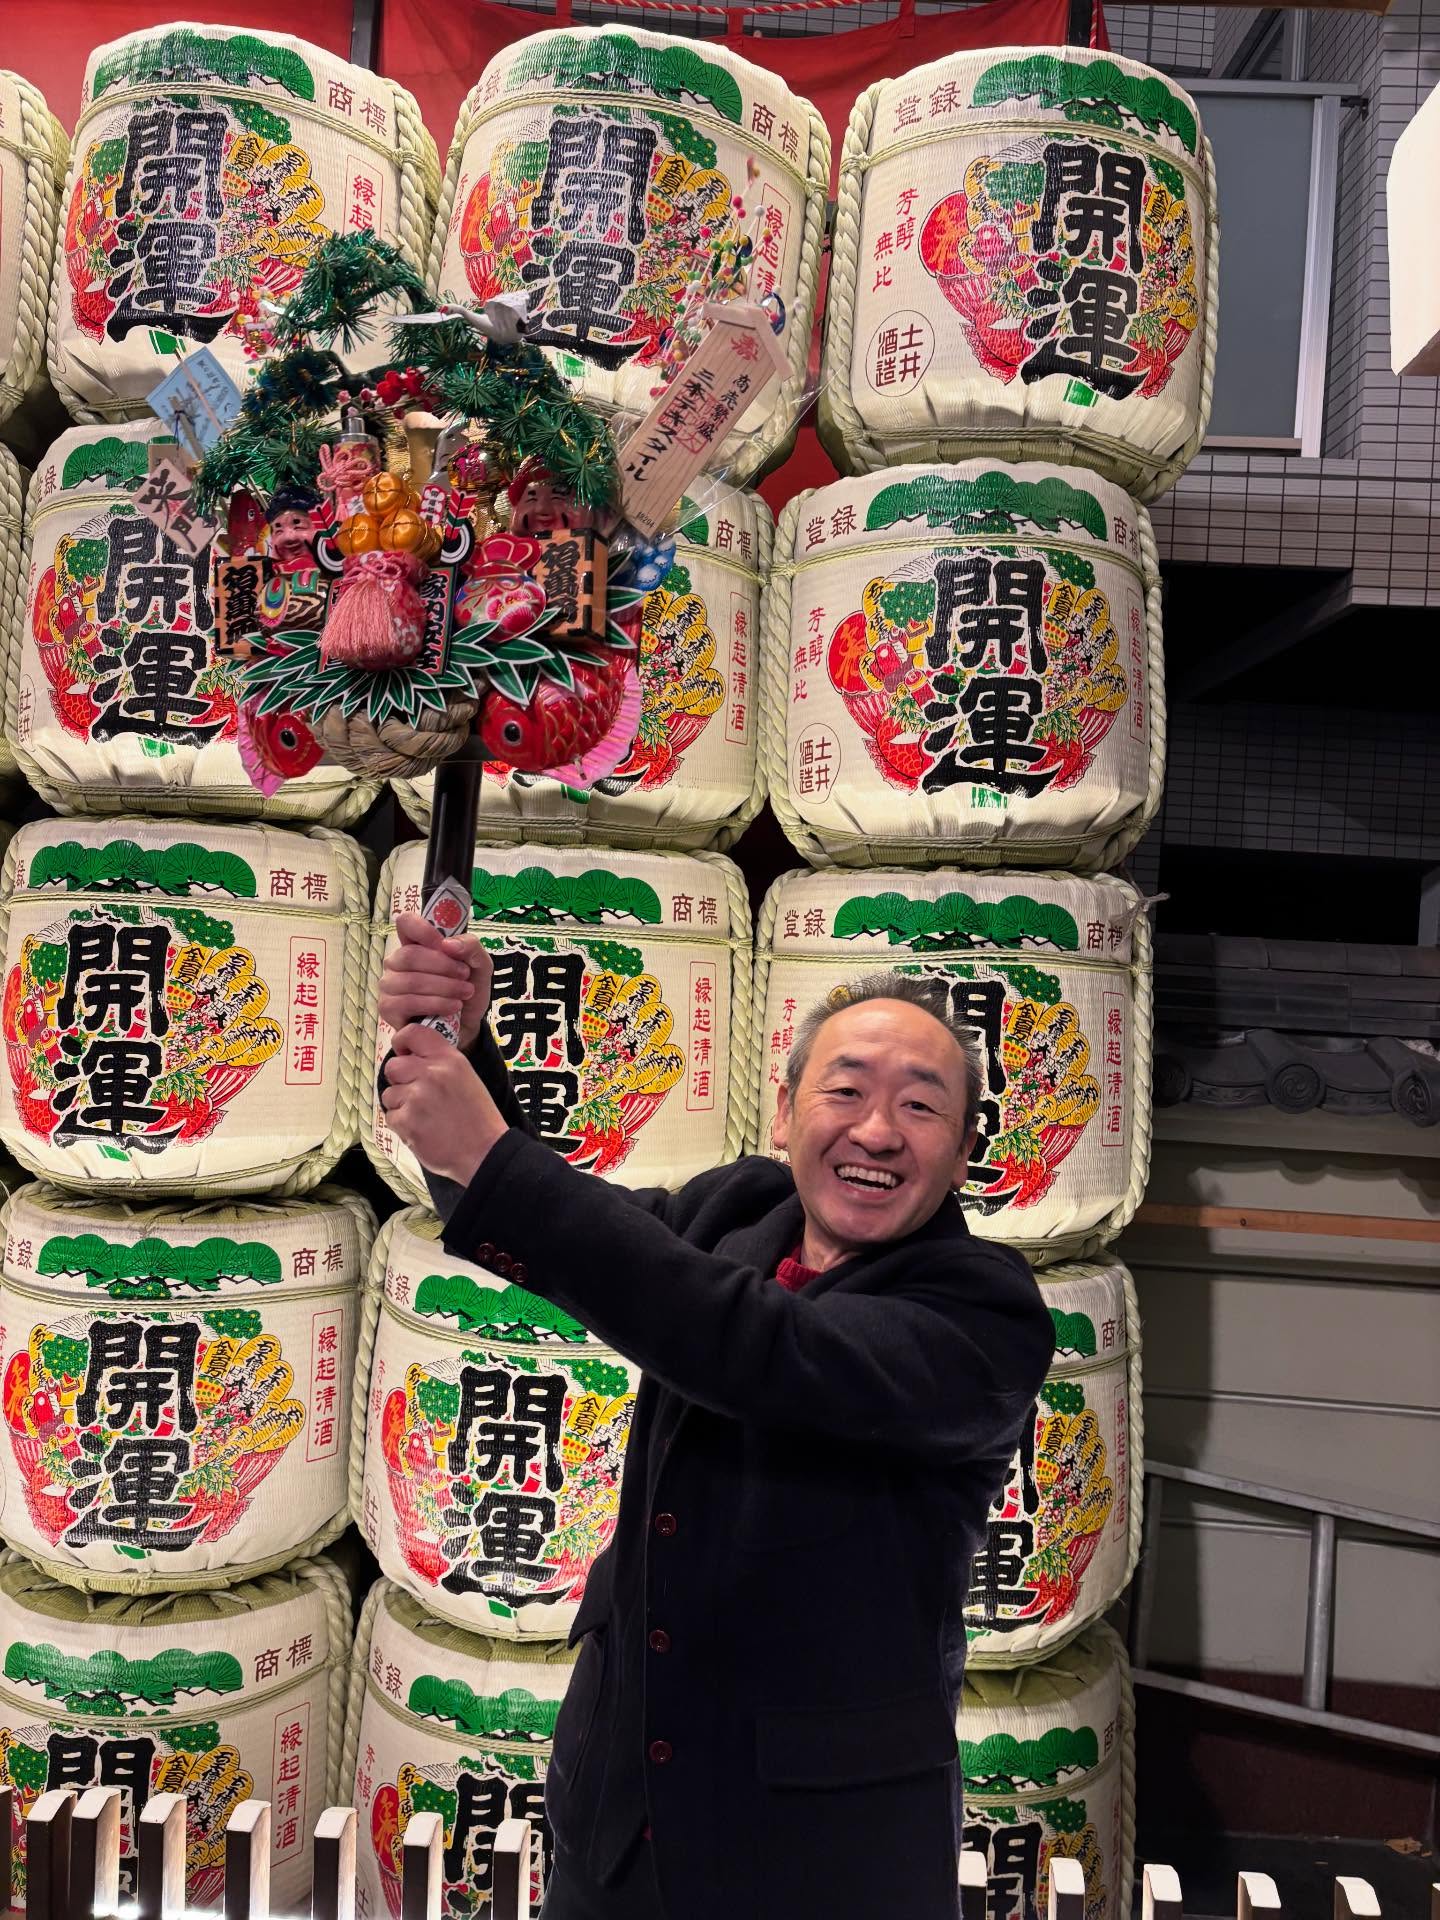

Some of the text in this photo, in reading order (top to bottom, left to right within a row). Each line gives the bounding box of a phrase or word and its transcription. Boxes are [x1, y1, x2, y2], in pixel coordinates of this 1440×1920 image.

[328, 79, 387, 136] 商標
[752, 102, 800, 162] 商標
[894, 82, 961, 133] 登録
[107, 110, 233, 344] 開運
[521, 118, 658, 370] 開運
[1021, 143, 1149, 400] 開運
[698, 374, 751, 442] 商売繁盛
[876, 327, 898, 387] 酒造
[899, 324, 923, 382] 土井
[625, 367, 715, 481] 三本テキスタイル
[716, 519, 752, 560] 商標
[805, 505, 858, 552] 登録
[91, 518, 231, 749] 開運
[731, 608, 748, 731] 縁起清酒
[920, 556, 1063, 798] 開運
[814, 738, 832, 792] 土井
[269, 868, 329, 902] 商標
[671, 893, 719, 925] 商標
[783, 908, 826, 940] 登録
[53, 923, 180, 1154] 開運
[293, 952, 321, 1072] 縁起清酒
[693, 977, 713, 1098] 縁起清酒
[1107, 1009, 1122, 1133] 縁起清酒
[292, 1244, 344, 1277] 商標
[64, 1321, 214, 1551] 開運
[315, 1327, 338, 1446] 縁起清酒
[441, 1366, 578, 1608] 開運
[254, 1634, 313, 1682] 商標
[275, 1721, 304, 1850] 縁起清酒
